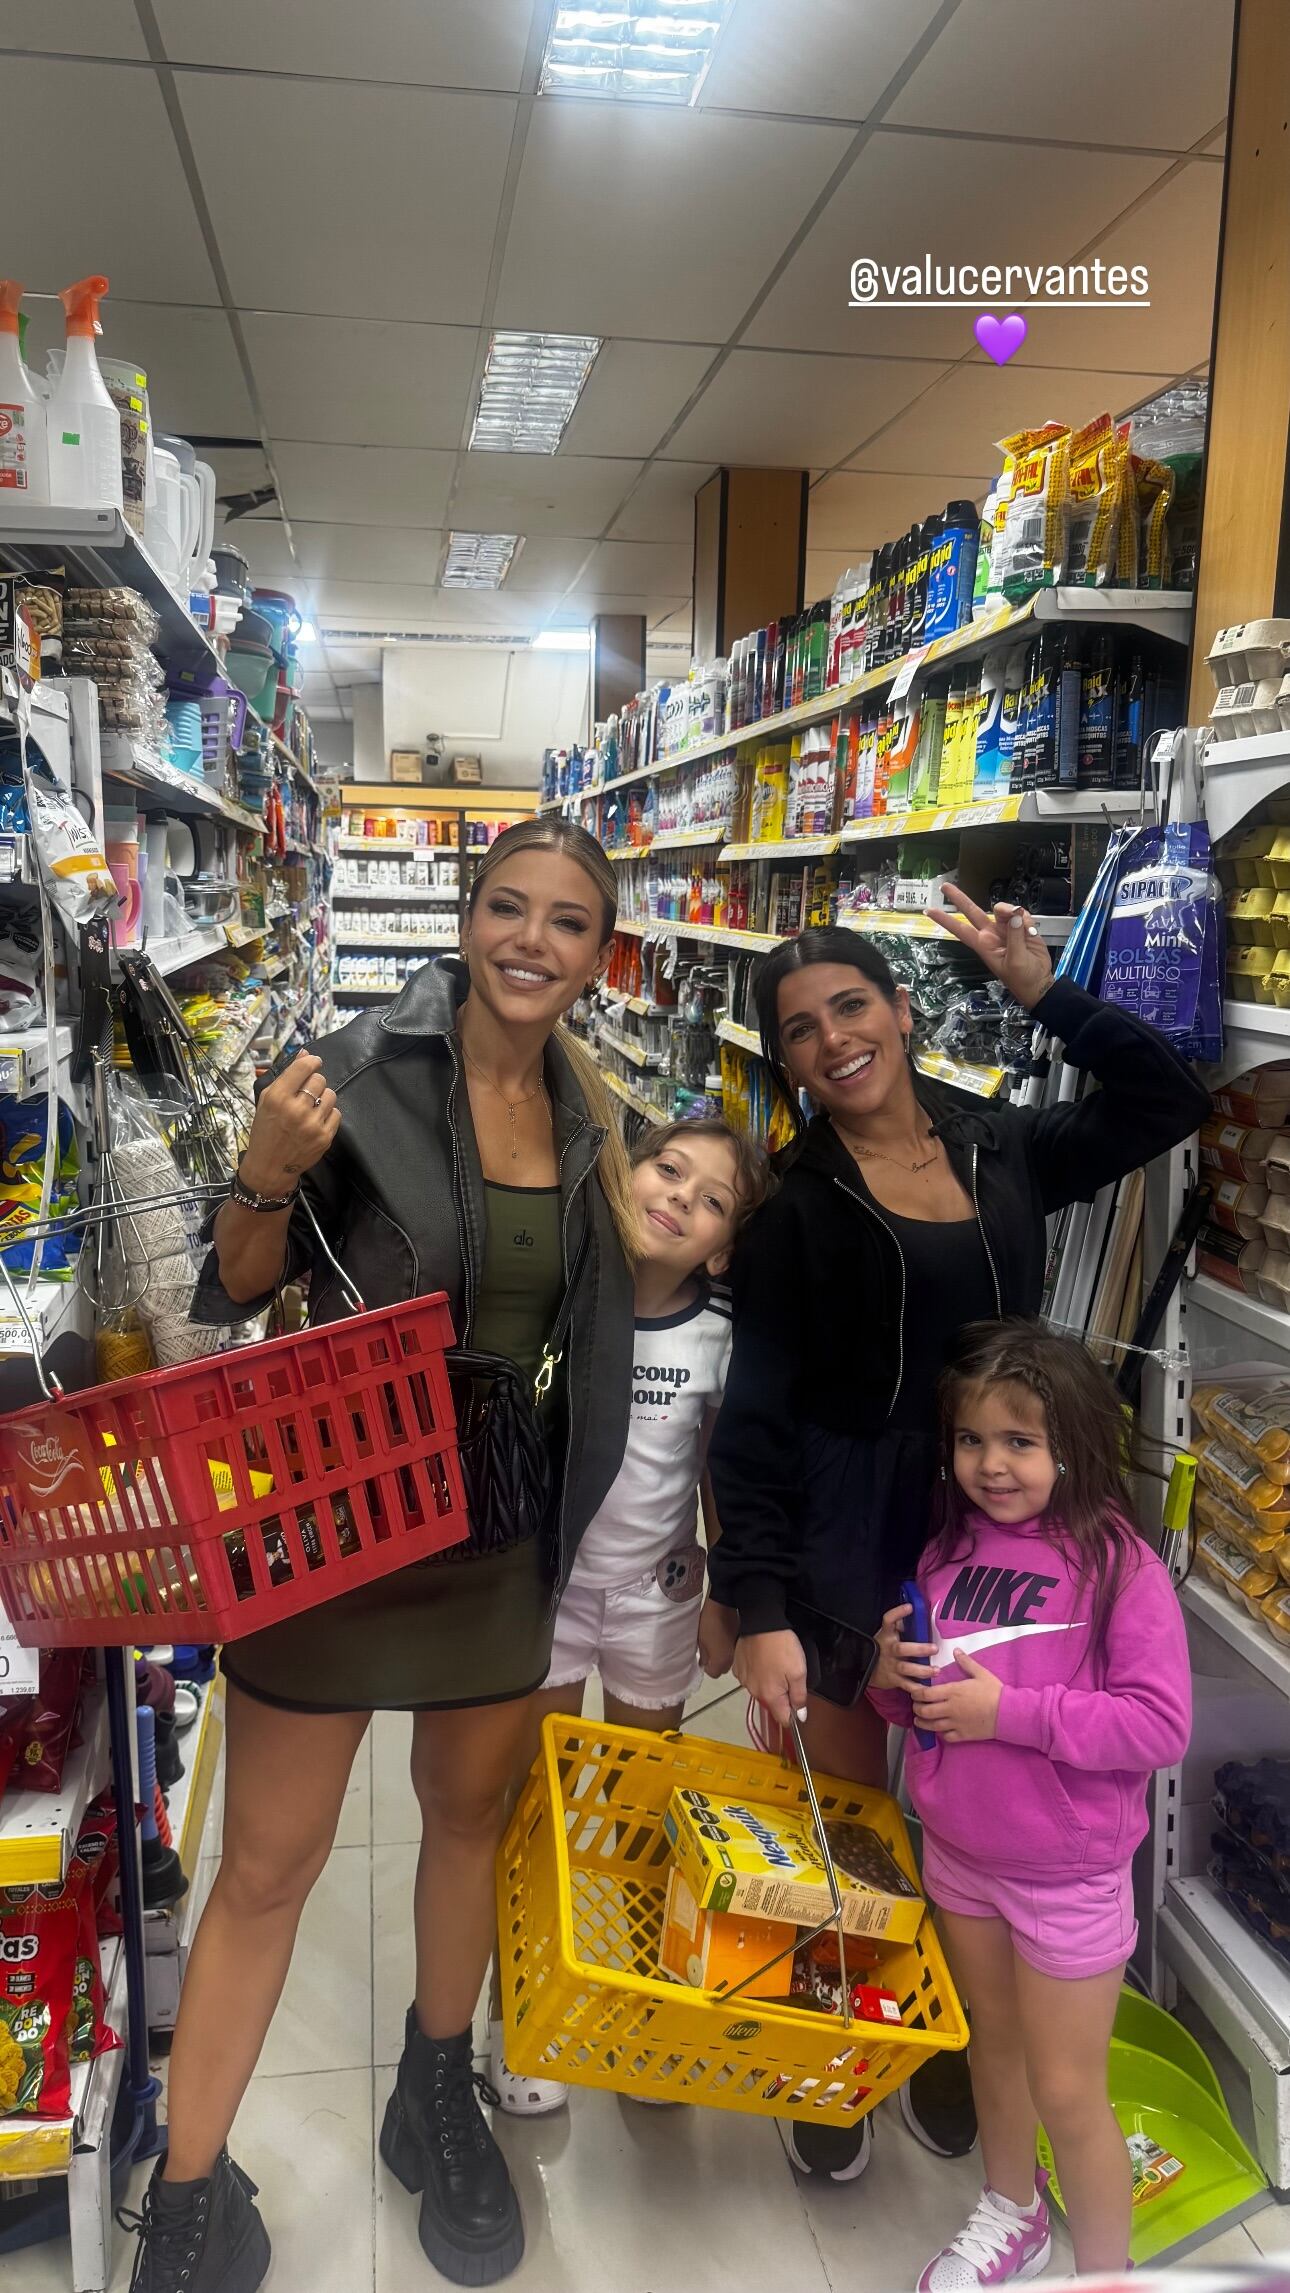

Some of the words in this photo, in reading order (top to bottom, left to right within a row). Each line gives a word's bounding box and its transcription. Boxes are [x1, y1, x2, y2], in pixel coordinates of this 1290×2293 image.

[1120, 880, 1182, 900] SIPACK
[1108, 949, 1181, 965] BOLSAS
[1105, 966, 1181, 981] MULTIUSO
[513, 1229, 535, 1247] alo
[939, 1565, 1061, 1627] NIKE
[722, 1804, 797, 1869] Nesquik
[21, 2005, 37, 2020] RE
[14, 2014, 43, 2032] DON
[16, 2026, 39, 2042] DO
